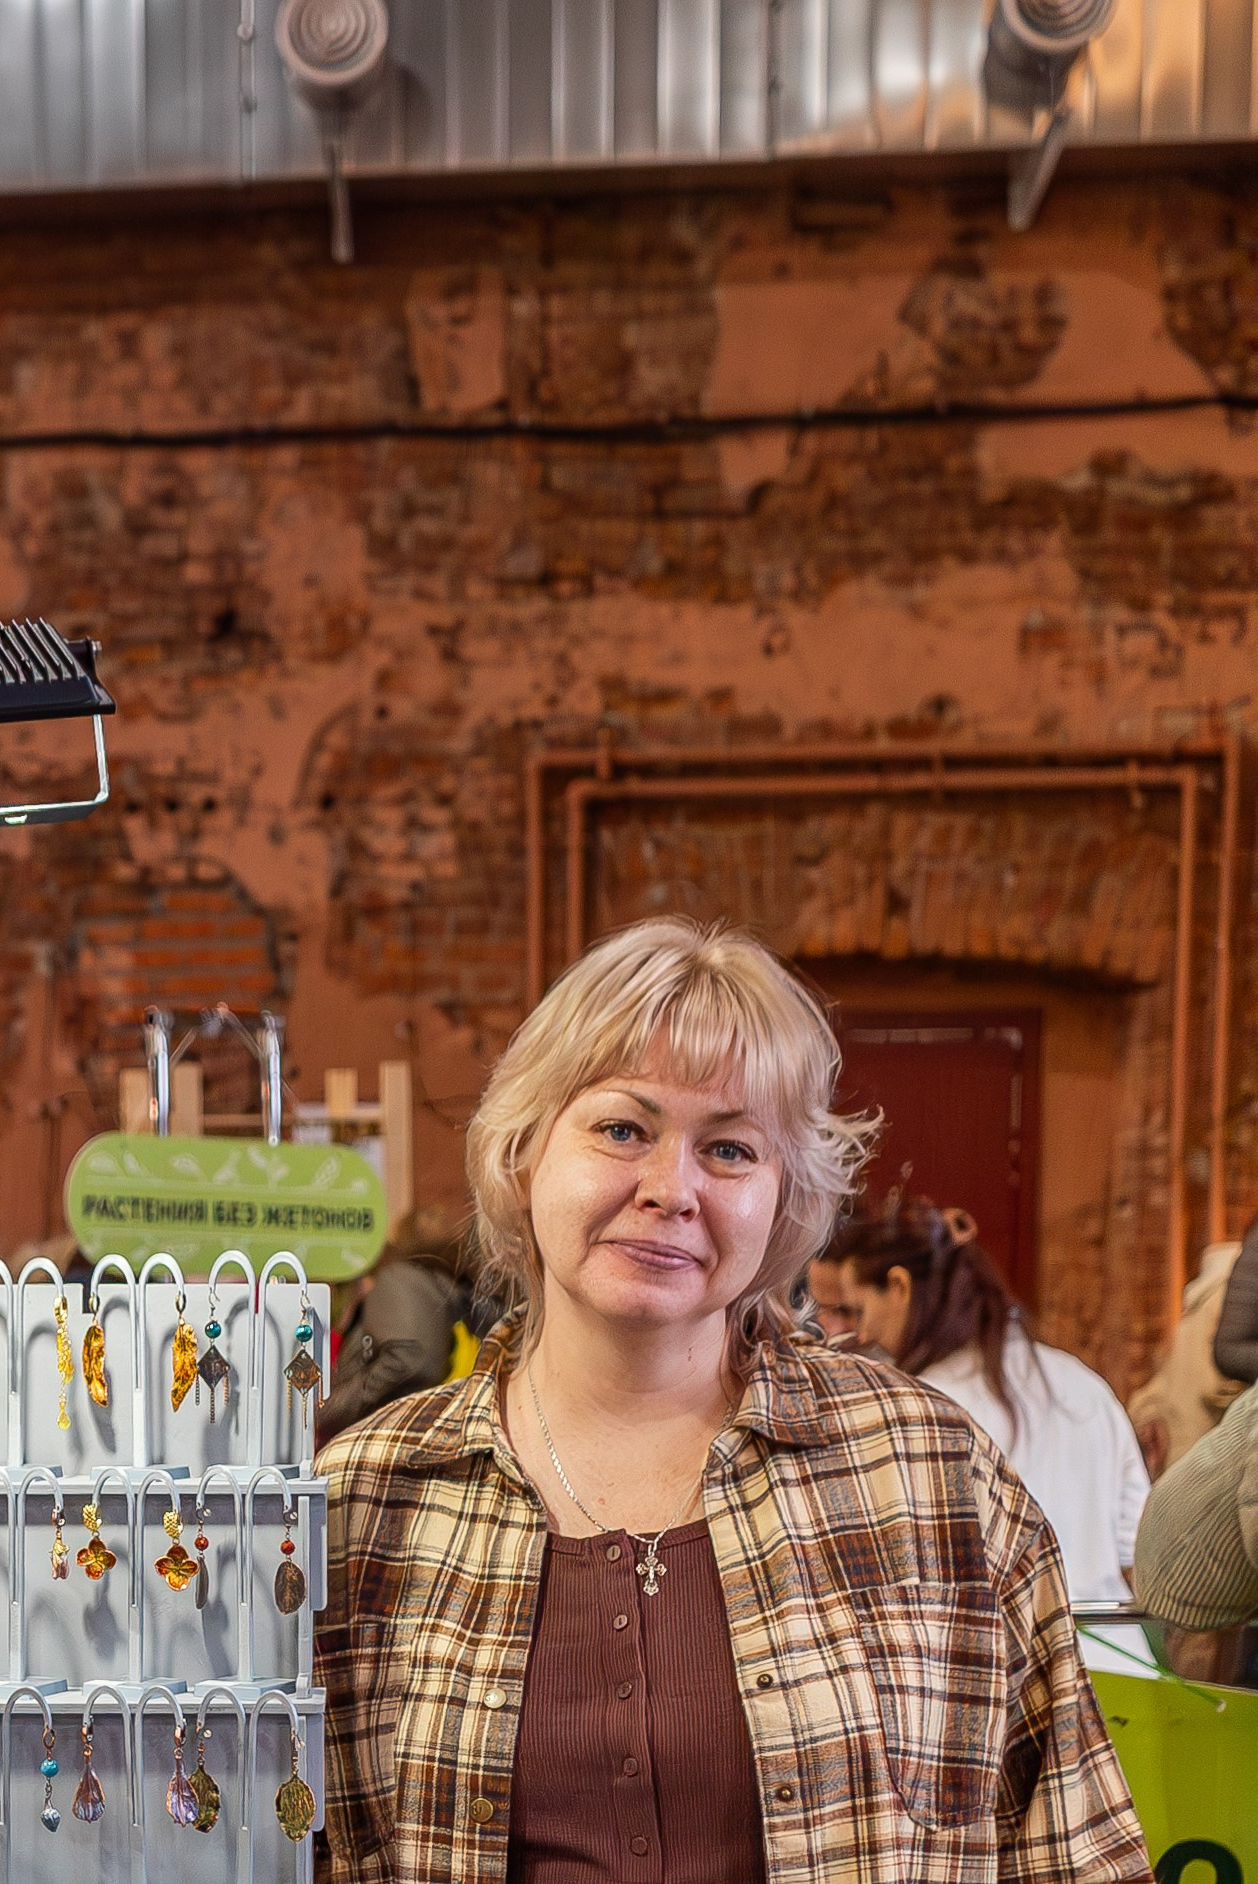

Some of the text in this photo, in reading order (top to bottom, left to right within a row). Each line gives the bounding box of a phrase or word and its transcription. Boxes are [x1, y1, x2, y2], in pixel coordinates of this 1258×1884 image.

[82, 1194, 376, 1232] РАСТЕНИЯ БЕЗ ЖЕТОНОВ
